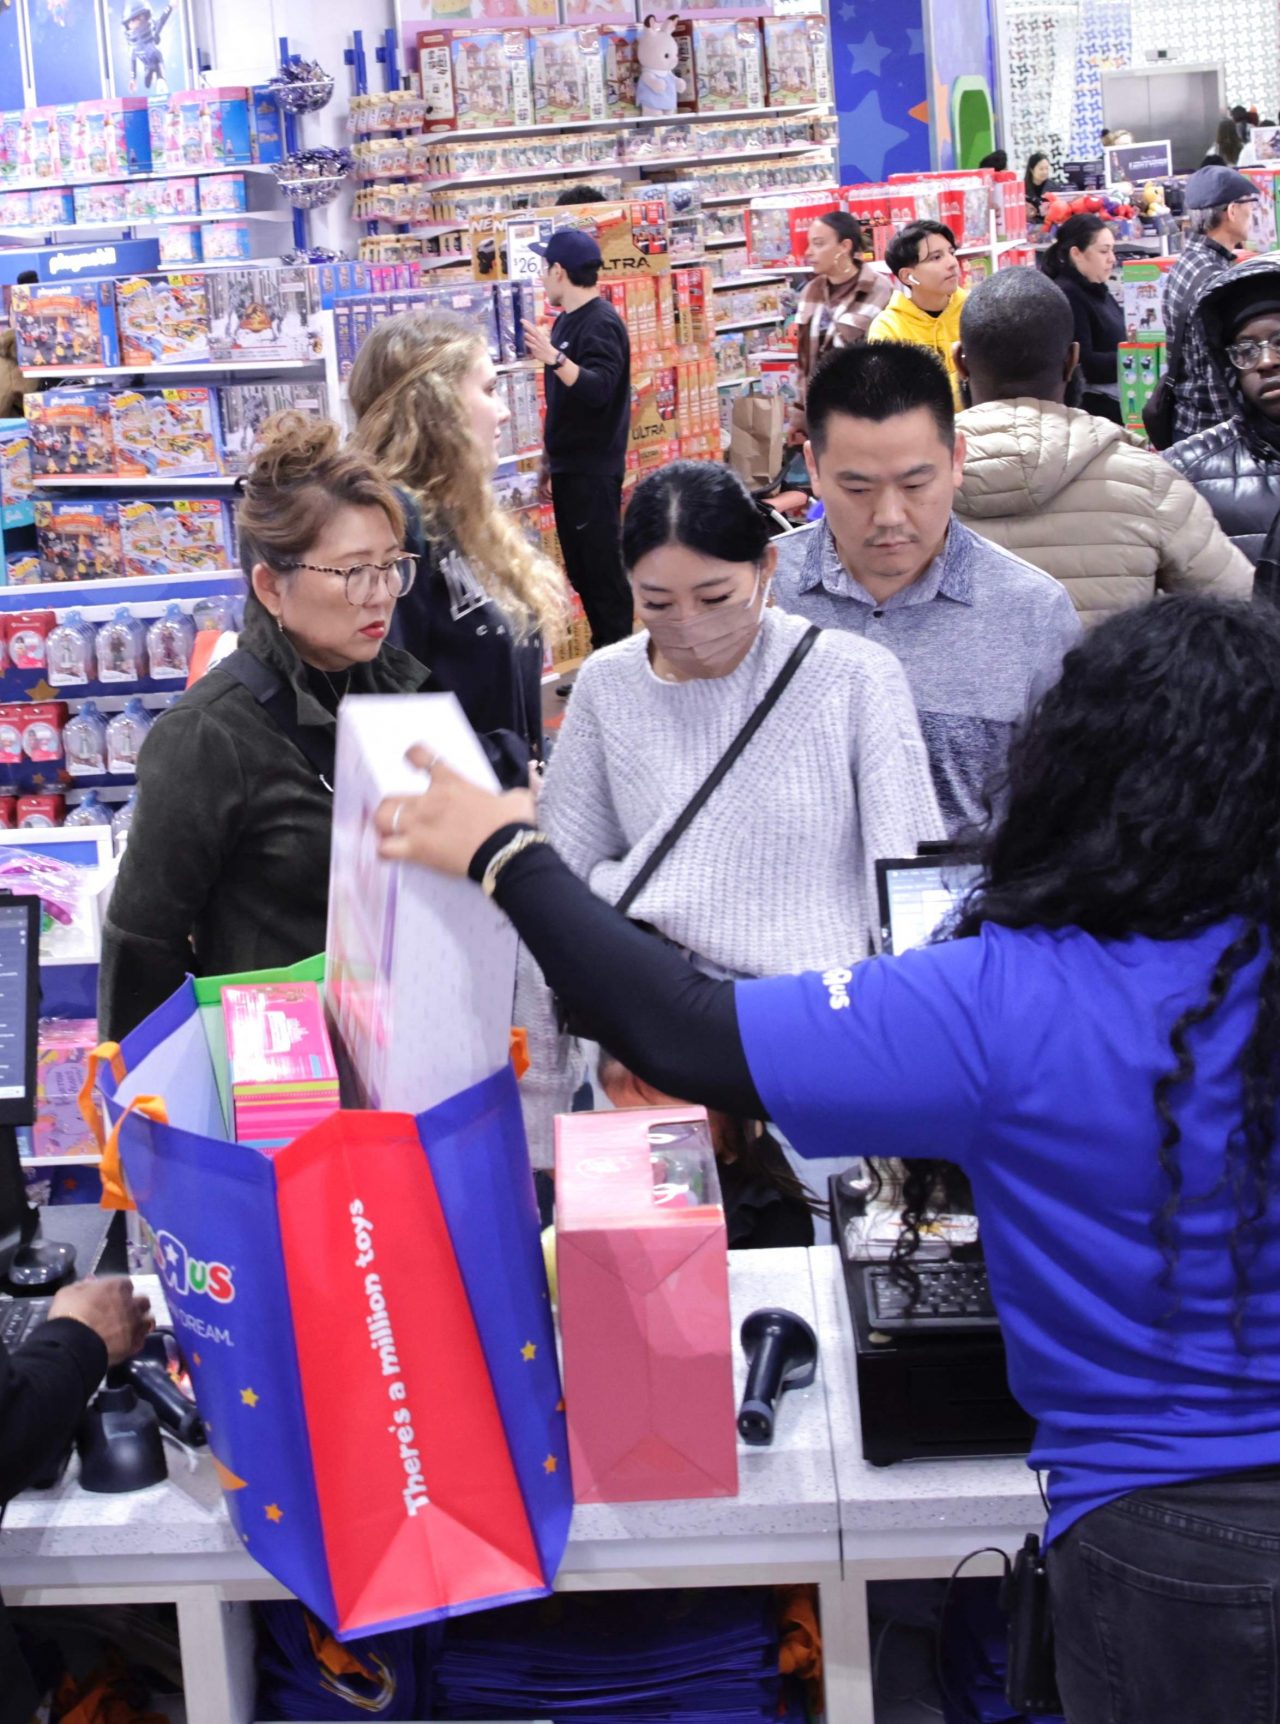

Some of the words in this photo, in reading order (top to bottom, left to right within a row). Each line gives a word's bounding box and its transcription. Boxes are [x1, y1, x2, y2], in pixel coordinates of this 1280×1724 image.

[601, 257, 652, 271] LTRA
[631, 423, 668, 441] ULTRA
[349, 1198, 376, 1269] toys
[364, 1272, 401, 1376] million
[388, 1381, 407, 1401] a
[387, 1407, 431, 1518] There's
